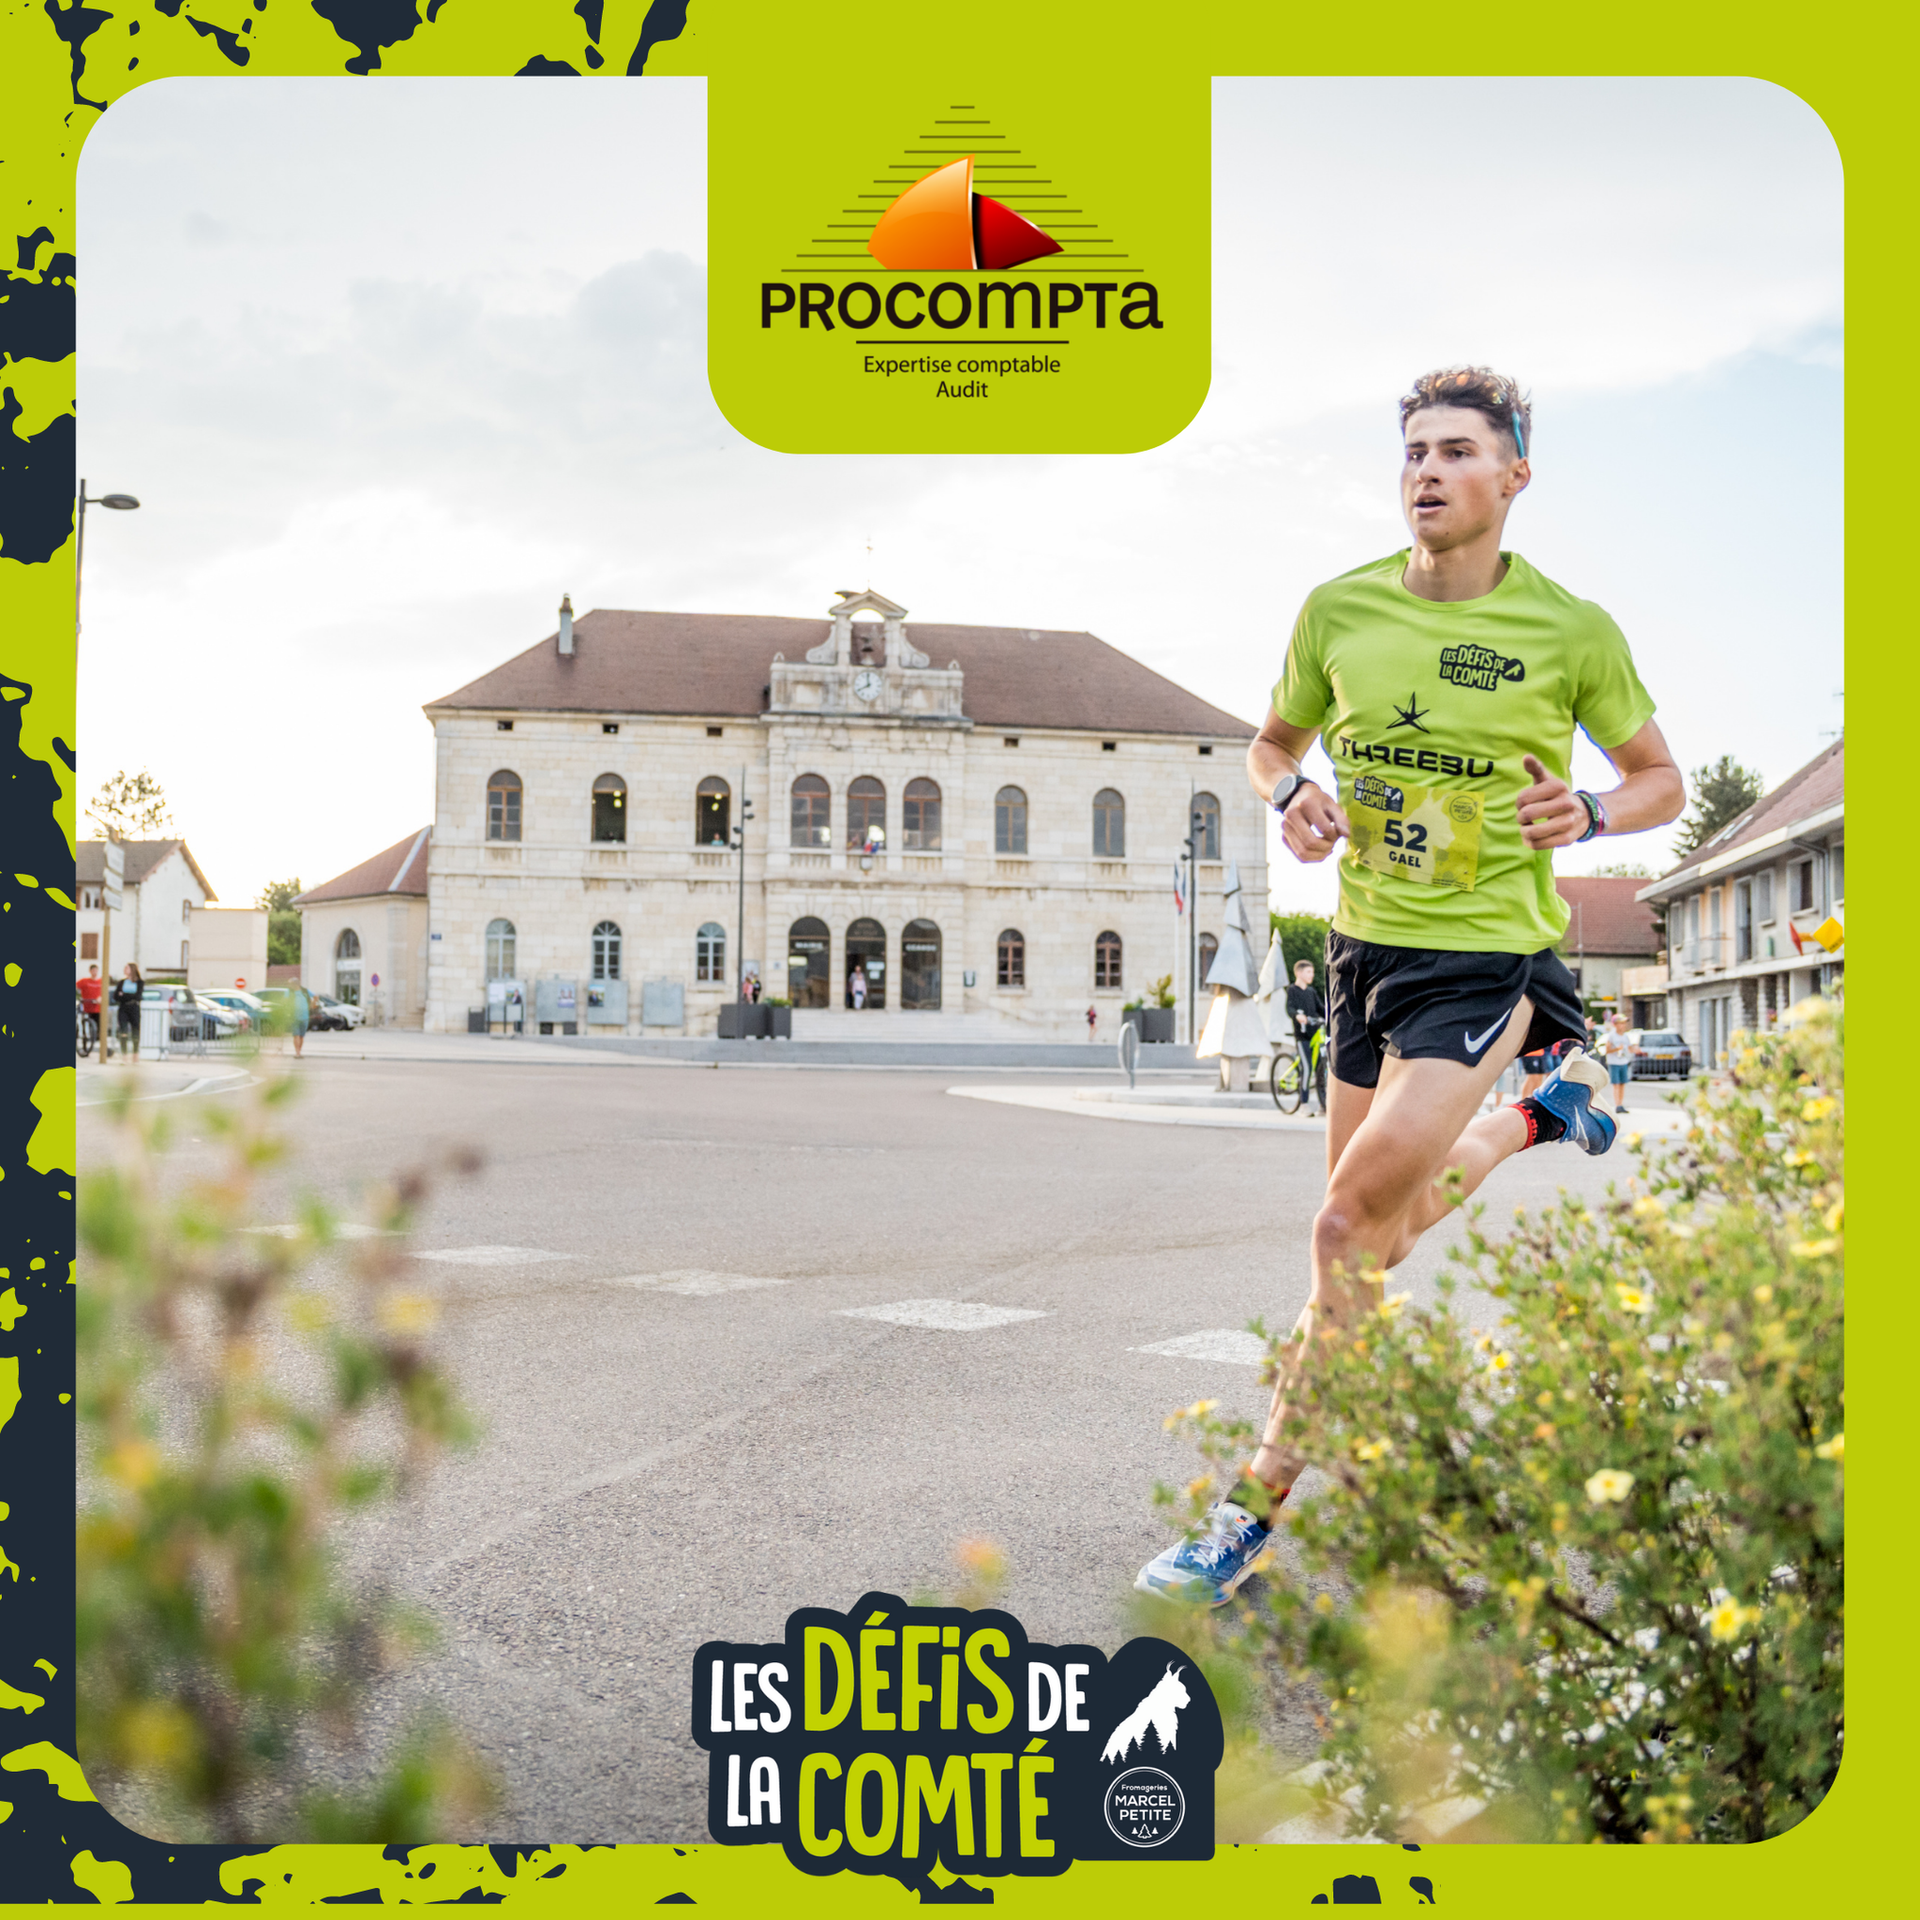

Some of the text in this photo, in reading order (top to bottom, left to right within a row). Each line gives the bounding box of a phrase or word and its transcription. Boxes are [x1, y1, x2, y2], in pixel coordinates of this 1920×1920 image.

[1442, 649, 1458, 662] LES
[1493, 658, 1506, 671] DE
[1442, 664, 1498, 689] LA COMTÉ
[1383, 818, 1428, 853] 52
[1388, 850, 1422, 868] GAEL
